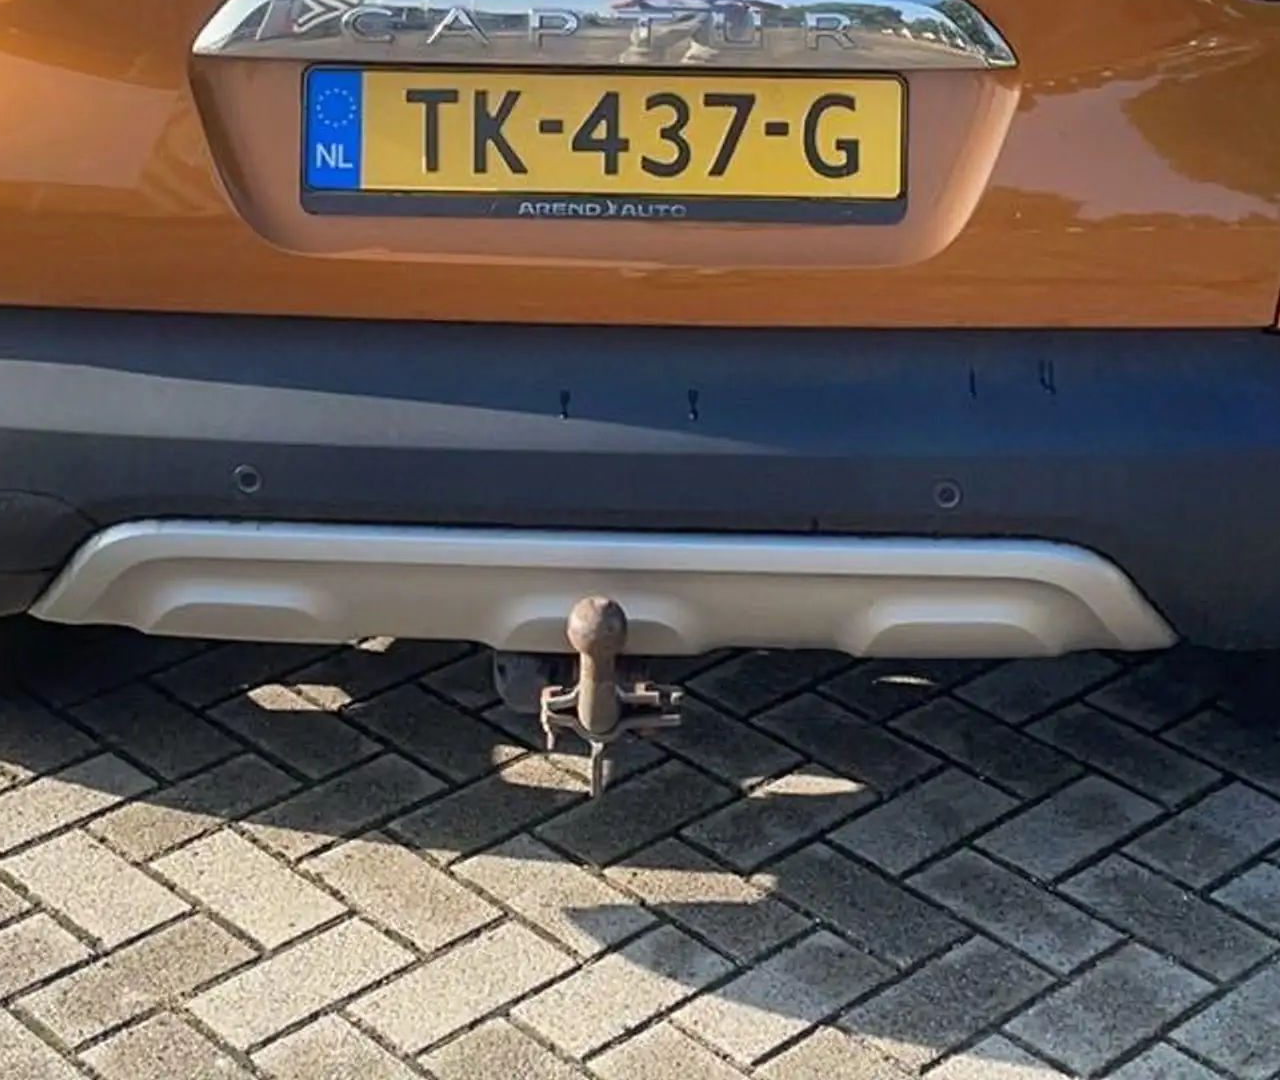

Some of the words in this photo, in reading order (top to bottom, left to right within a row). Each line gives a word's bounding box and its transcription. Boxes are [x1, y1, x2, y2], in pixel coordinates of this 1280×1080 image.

[340, 4, 858, 50] CAPTUR
[406, 89, 860, 178] TK-437-G
[316, 143, 353, 169] NL
[519, 201, 602, 217] AREND
[621, 204, 687, 217] AUTO
